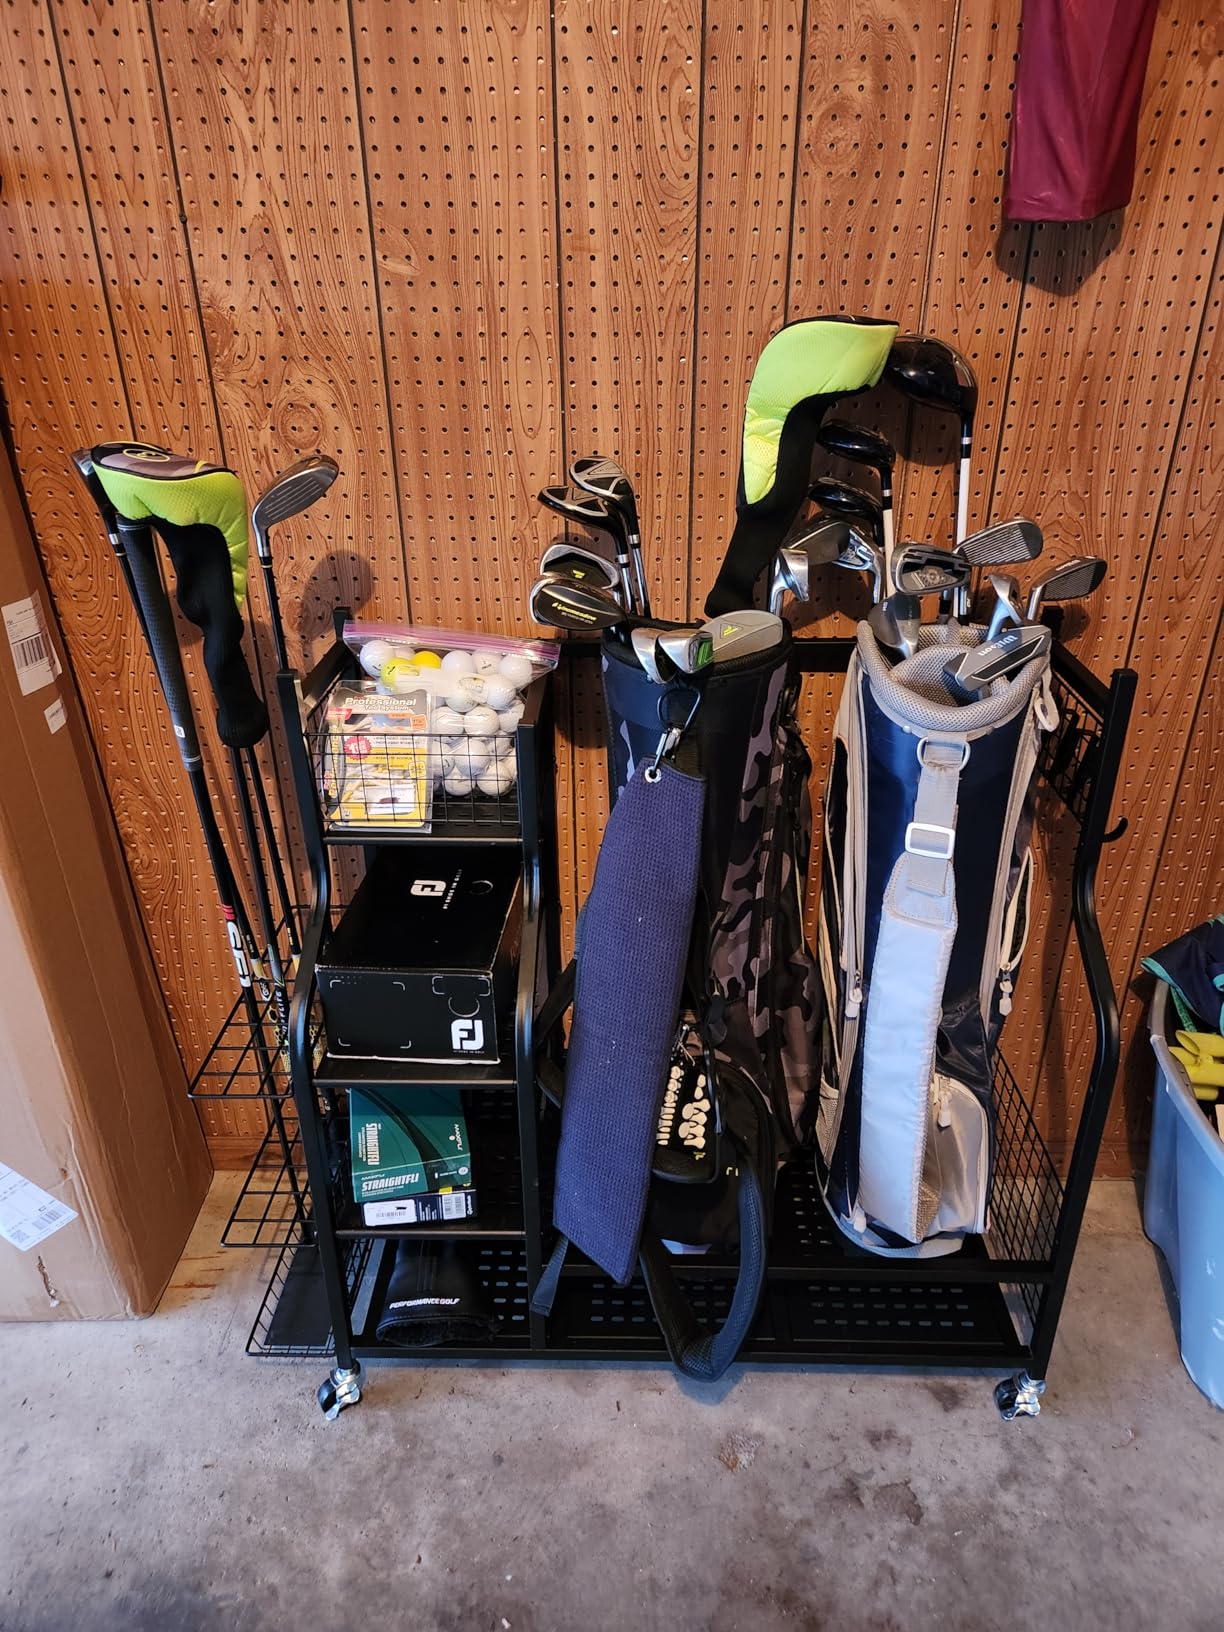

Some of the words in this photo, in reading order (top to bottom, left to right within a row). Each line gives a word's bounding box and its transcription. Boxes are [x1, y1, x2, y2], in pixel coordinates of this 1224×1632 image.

[345, 697, 417, 706] Professional
[450, 1019, 485, 1051] FJ
[361, 1172, 419, 1191] STRAIGHTFLI
[389, 1298, 440, 1310] PERFORMANCE
